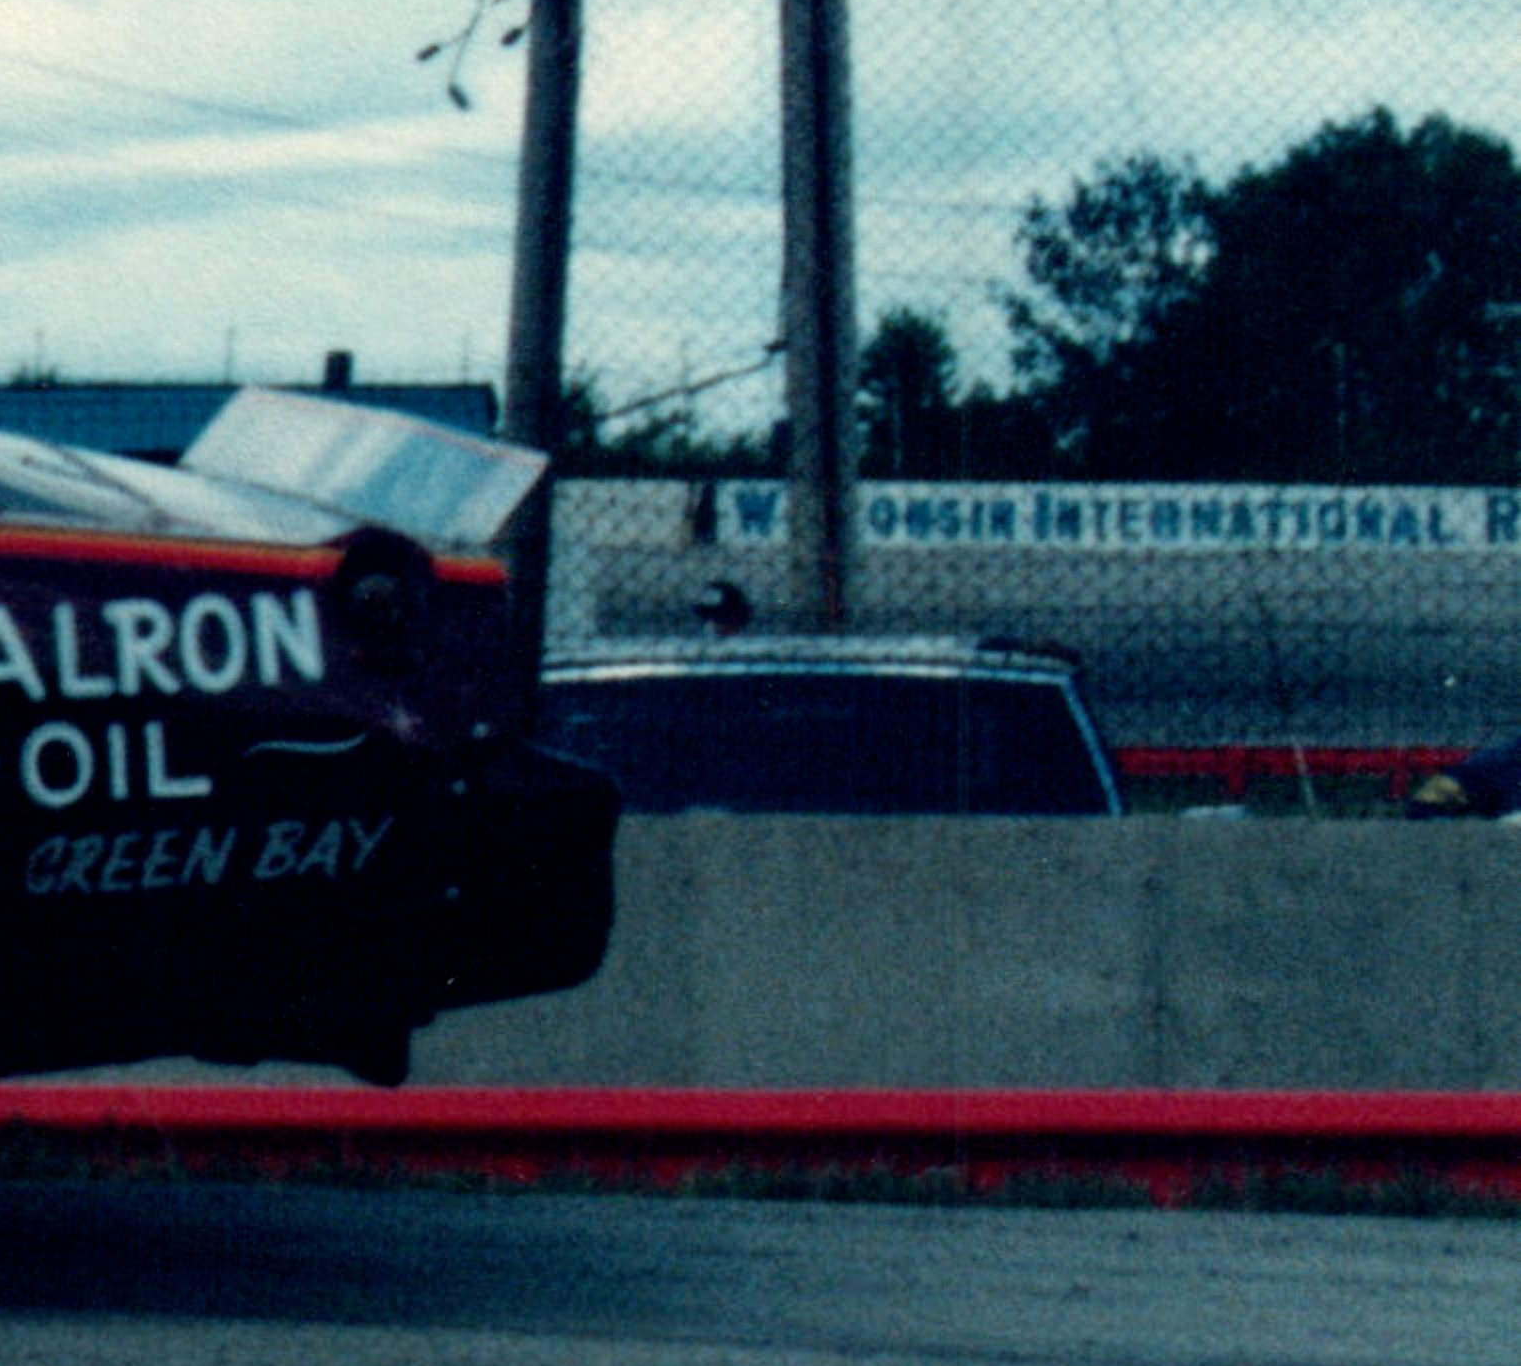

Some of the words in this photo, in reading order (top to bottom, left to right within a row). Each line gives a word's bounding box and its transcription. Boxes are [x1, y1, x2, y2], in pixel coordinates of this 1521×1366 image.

[734, 489, 1016, 540] WONSIN
[19, 721, 214, 810] OIL
[25, 826, 239, 895] GREEN
[252, 815, 395, 882] BAY
